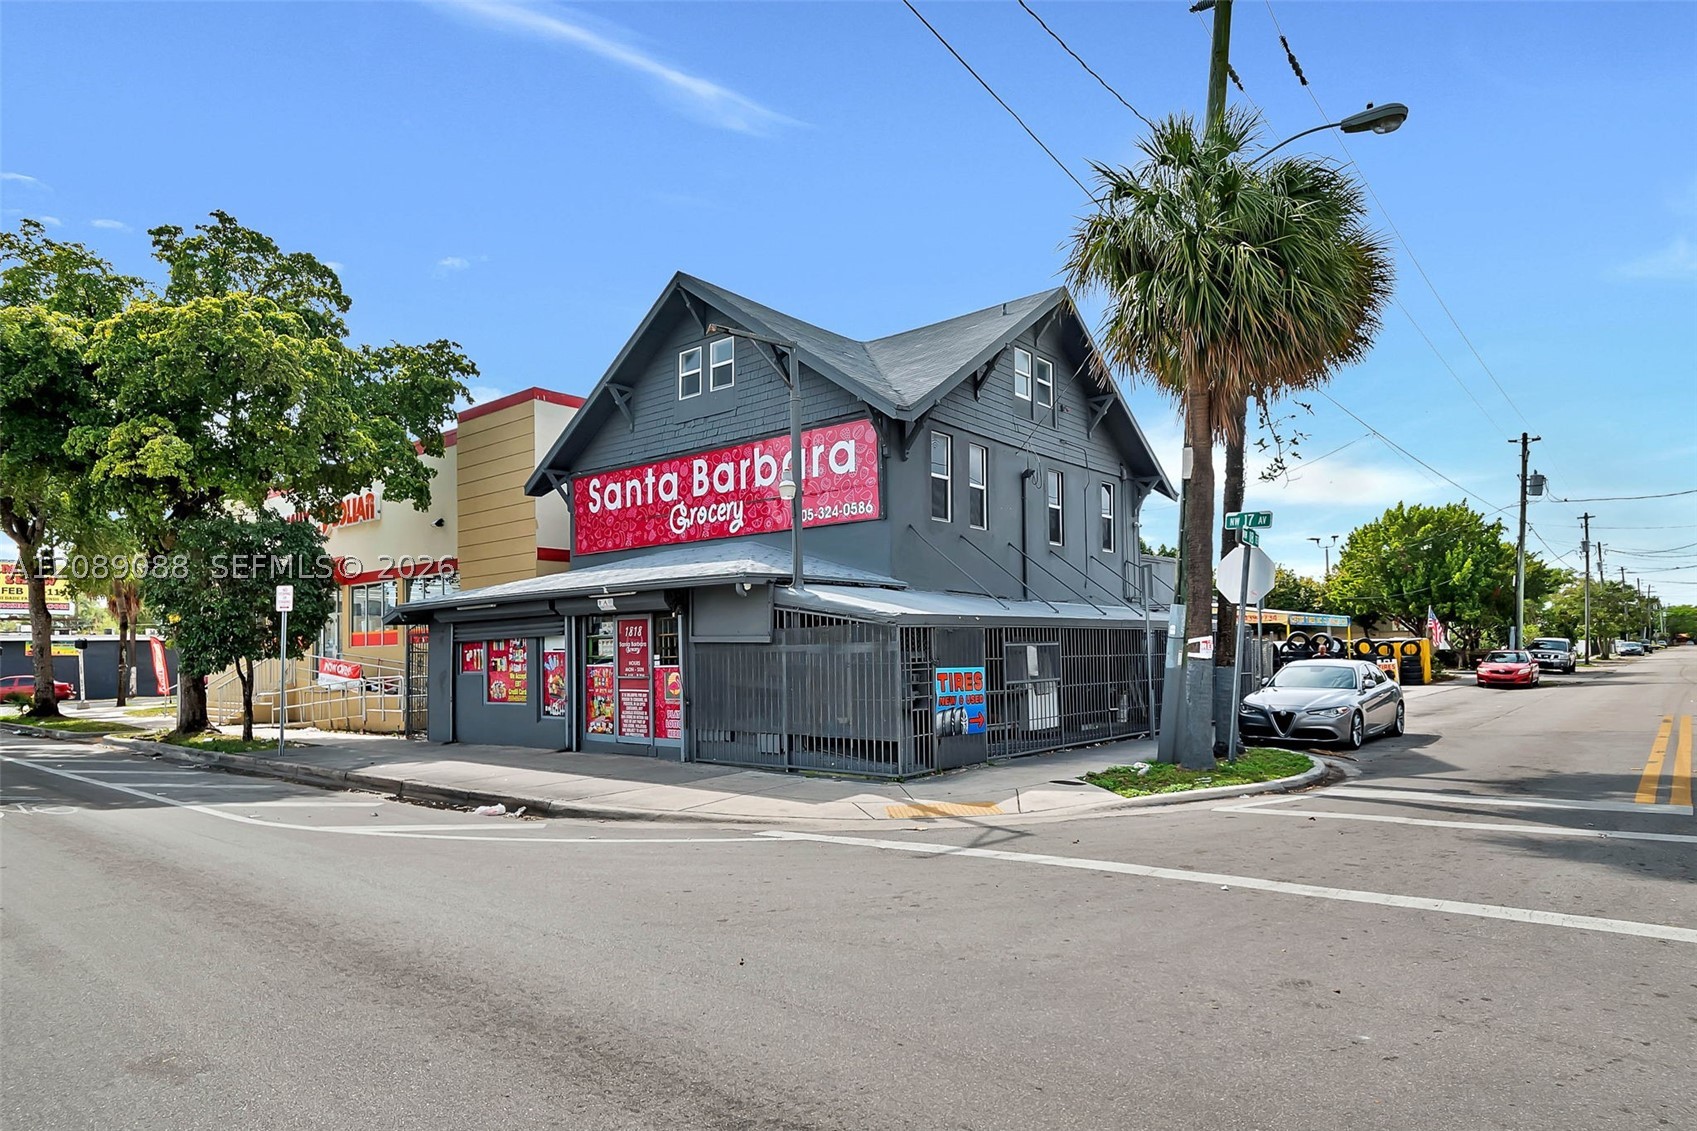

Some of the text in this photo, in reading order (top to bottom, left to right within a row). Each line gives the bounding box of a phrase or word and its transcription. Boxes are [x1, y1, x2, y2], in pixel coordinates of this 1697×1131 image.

[588, 468, 677, 514] Santa
[670, 501, 744, 533] Grocery
[802, 501, 873, 521] 05-324-0586
[1230, 514, 1267, 526] NW 17 AV
[1, 587, 24, 595] FEB
[625, 625, 643, 637] 1818
[937, 671, 983, 692] TIRES
[938, 696, 957, 706] NEW
[965, 694, 984, 705] USED
